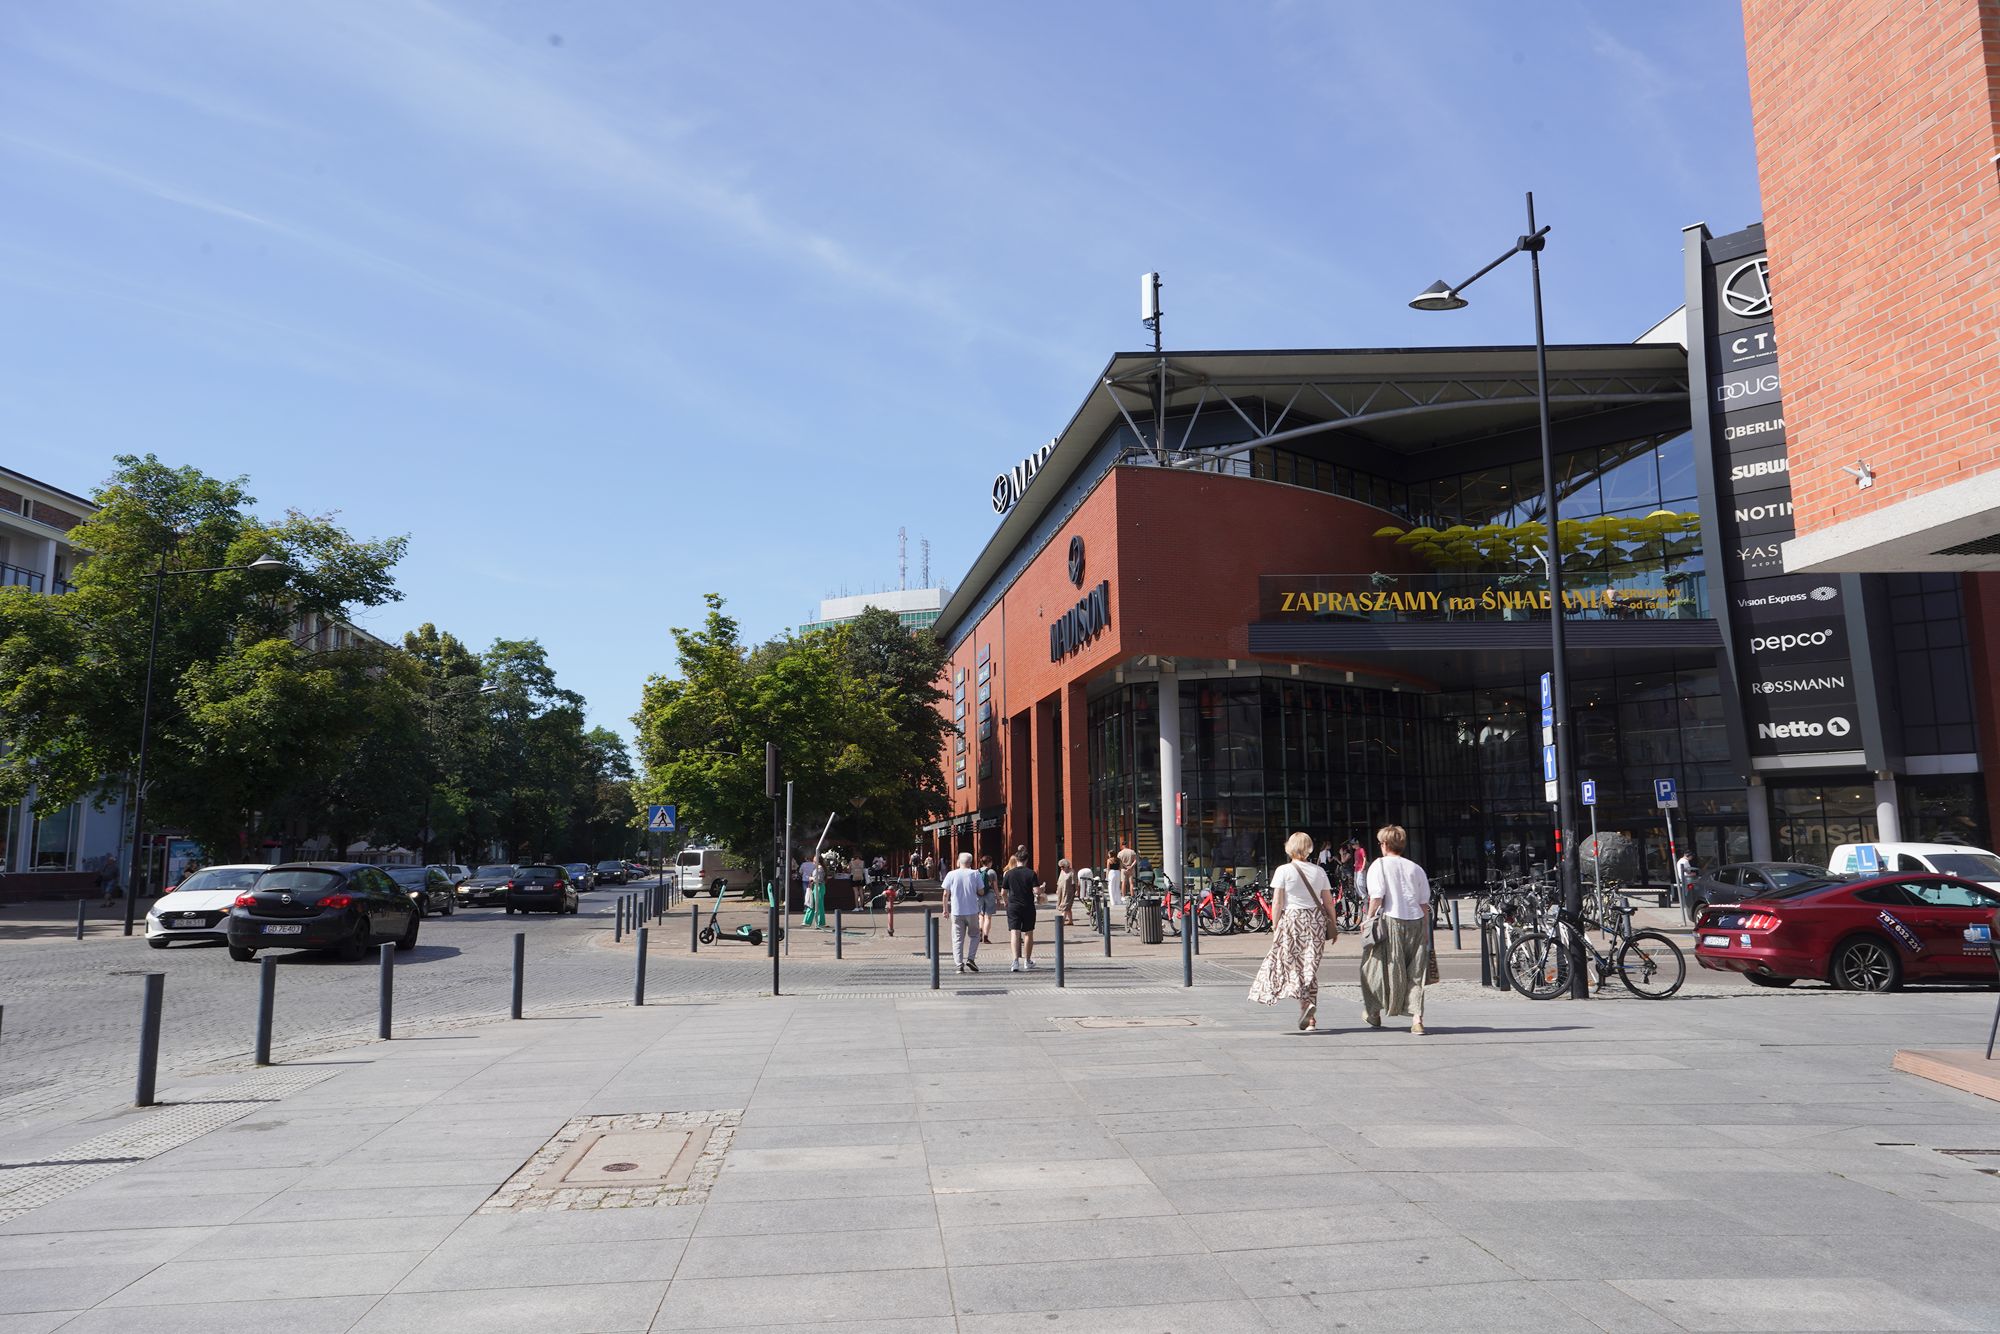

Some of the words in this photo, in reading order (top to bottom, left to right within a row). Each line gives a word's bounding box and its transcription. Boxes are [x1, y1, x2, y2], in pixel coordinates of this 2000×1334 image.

[1732, 333, 1777, 354] CT
[1717, 375, 1782, 401] DOUG
[1730, 458, 1790, 482] SUBW
[1280, 591, 1442, 611] ZAPRASZAMY
[1450, 597, 1476, 610] na
[1629, 599, 1643, 609] od
[1737, 597, 1767, 608] Vision
[1768, 592, 1807, 605] Express
[1050, 580, 1109, 663] MADISON
[1752, 676, 1845, 694] ROSSMANN
[1758, 720, 1824, 739] Netto
[1583, 784, 1592, 802] P
[1660, 781, 1671, 797] P
[1861, 849, 1873, 867] L
[1879, 911, 1896, 926] 797
[1895, 924, 1910, 940] 632
[1907, 938, 1921, 953] 231
